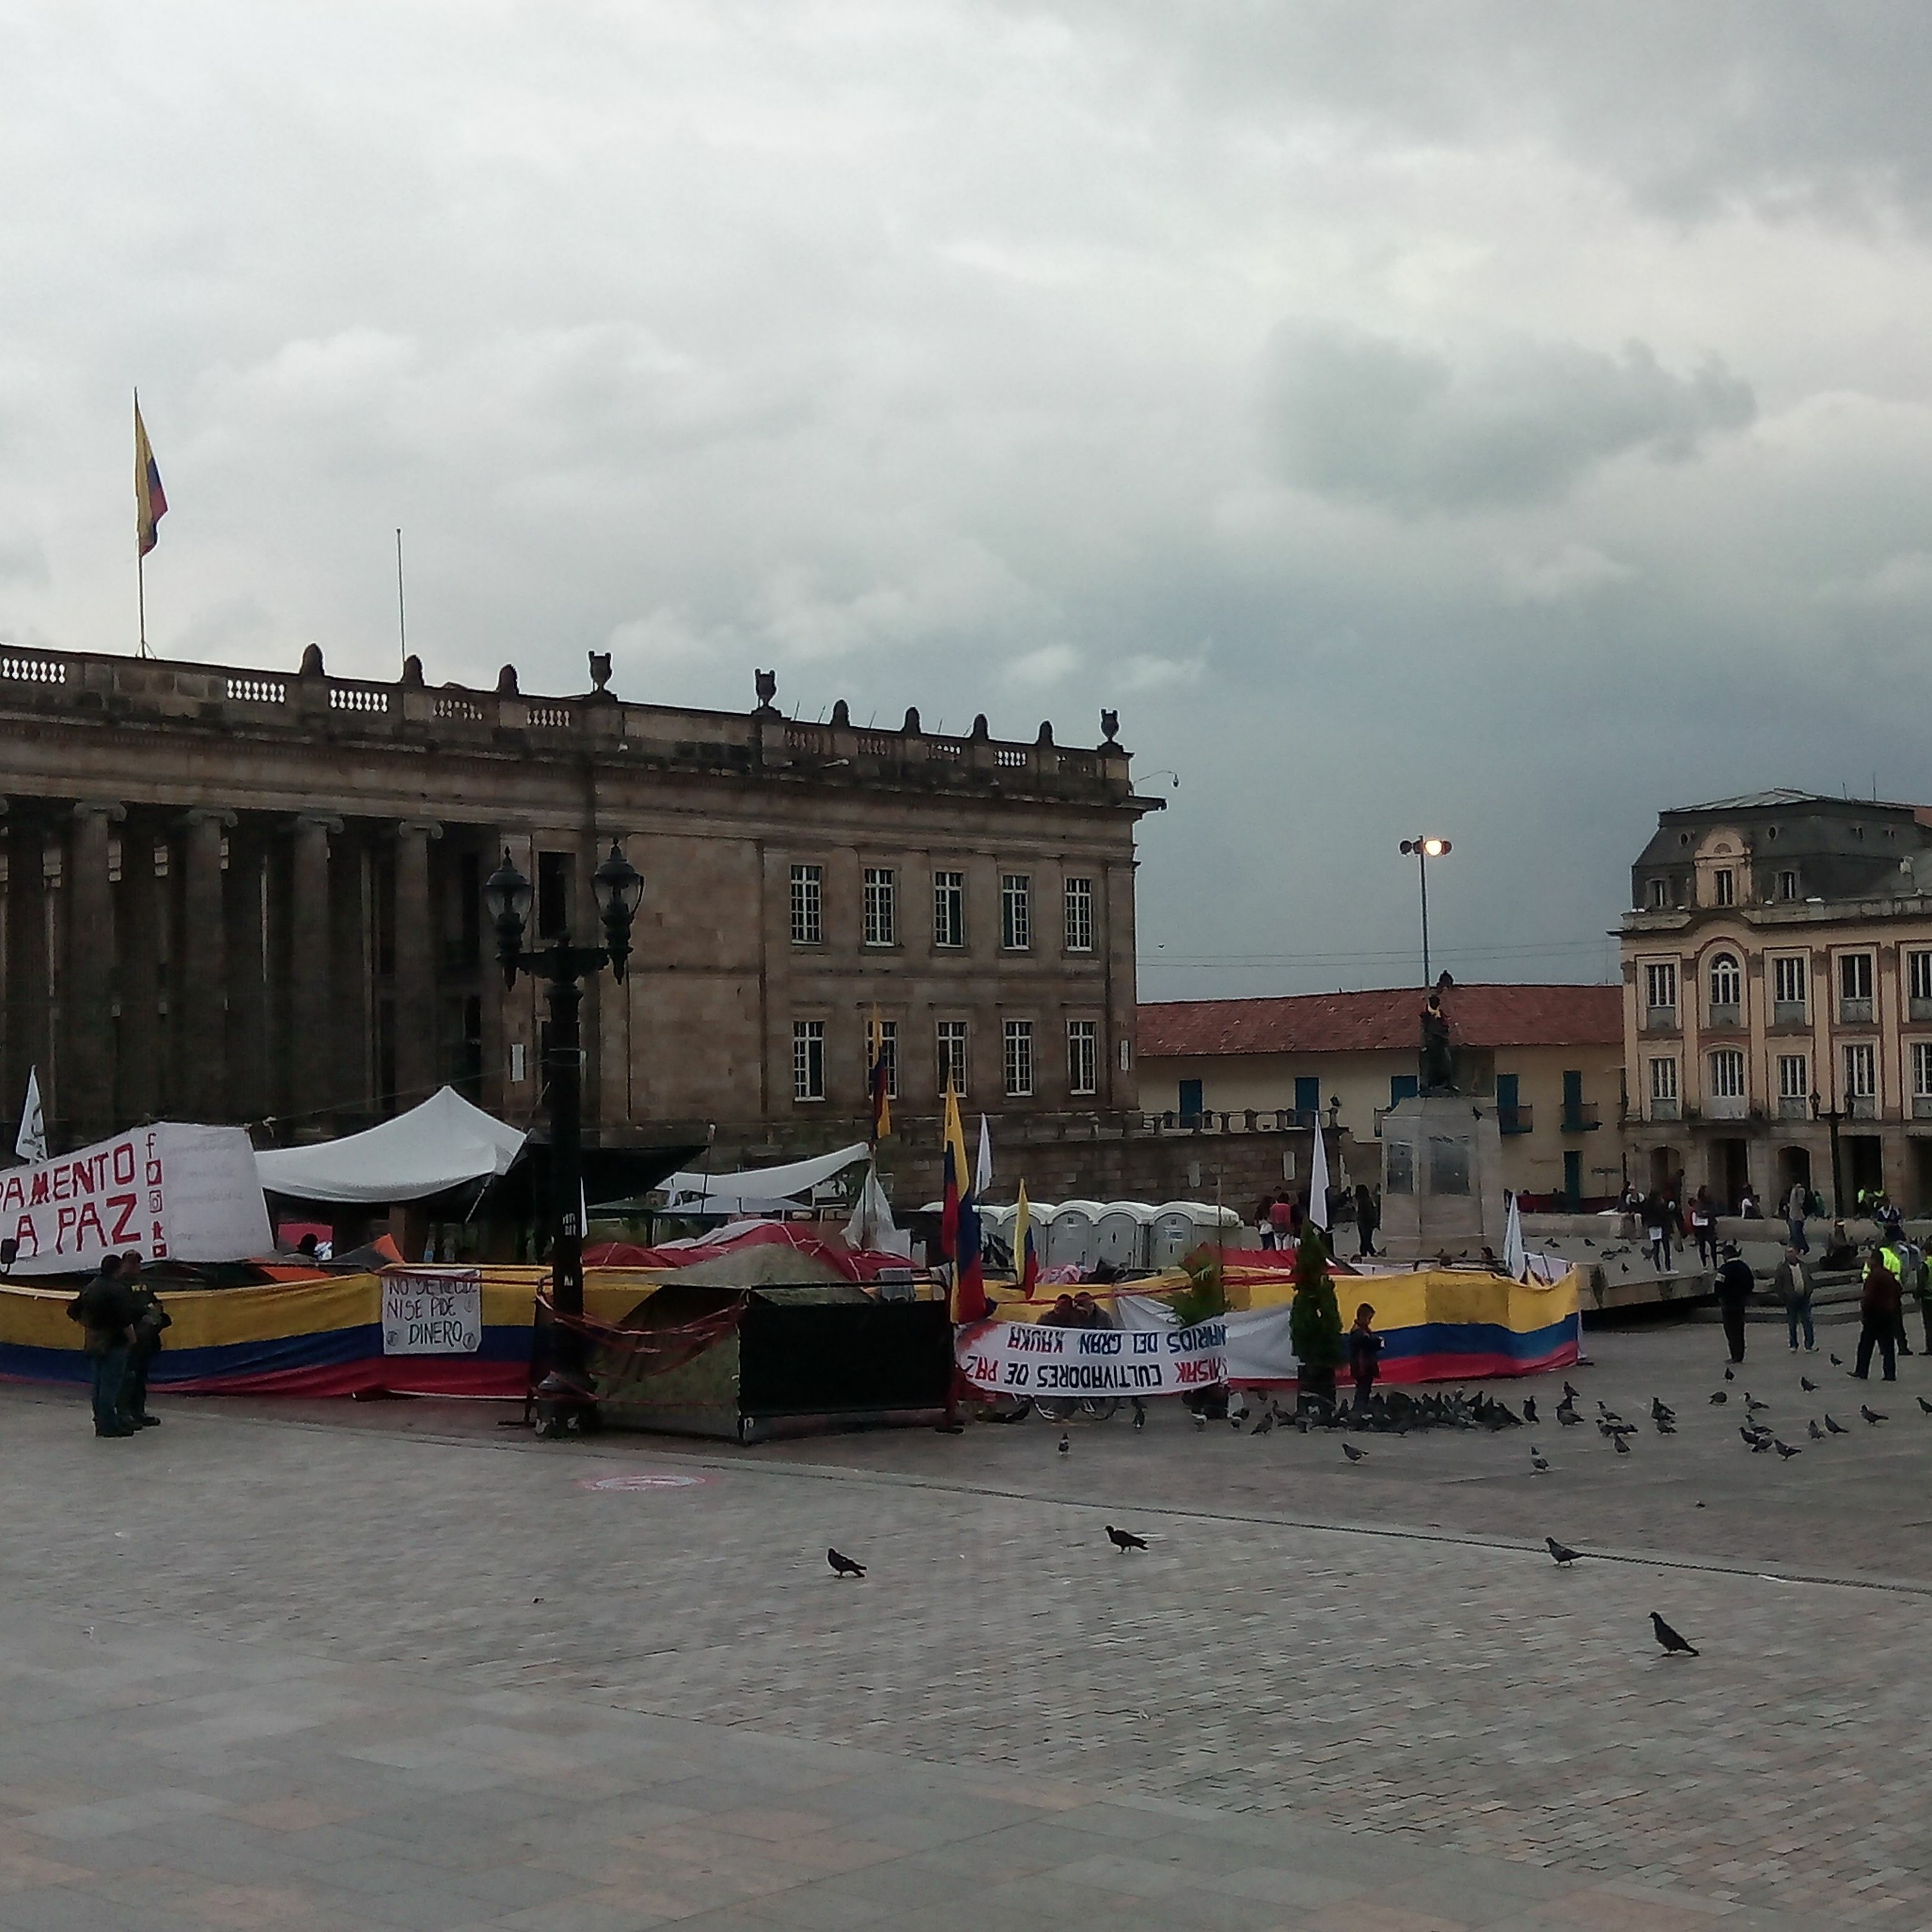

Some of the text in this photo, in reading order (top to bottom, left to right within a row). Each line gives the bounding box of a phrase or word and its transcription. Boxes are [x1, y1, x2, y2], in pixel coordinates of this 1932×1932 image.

[55, 1193, 141, 1255] PAZ
[408, 1320, 463, 1347] DINERO
[1006, 1327, 1066, 1354] KAUKA
[1079, 1334, 1122, 1354] GRAN
[965, 1355, 999, 1380] PAZ
[1004, 1362, 1029, 1385] DE
[1037, 1363, 1162, 1388] CULTIVADORES
